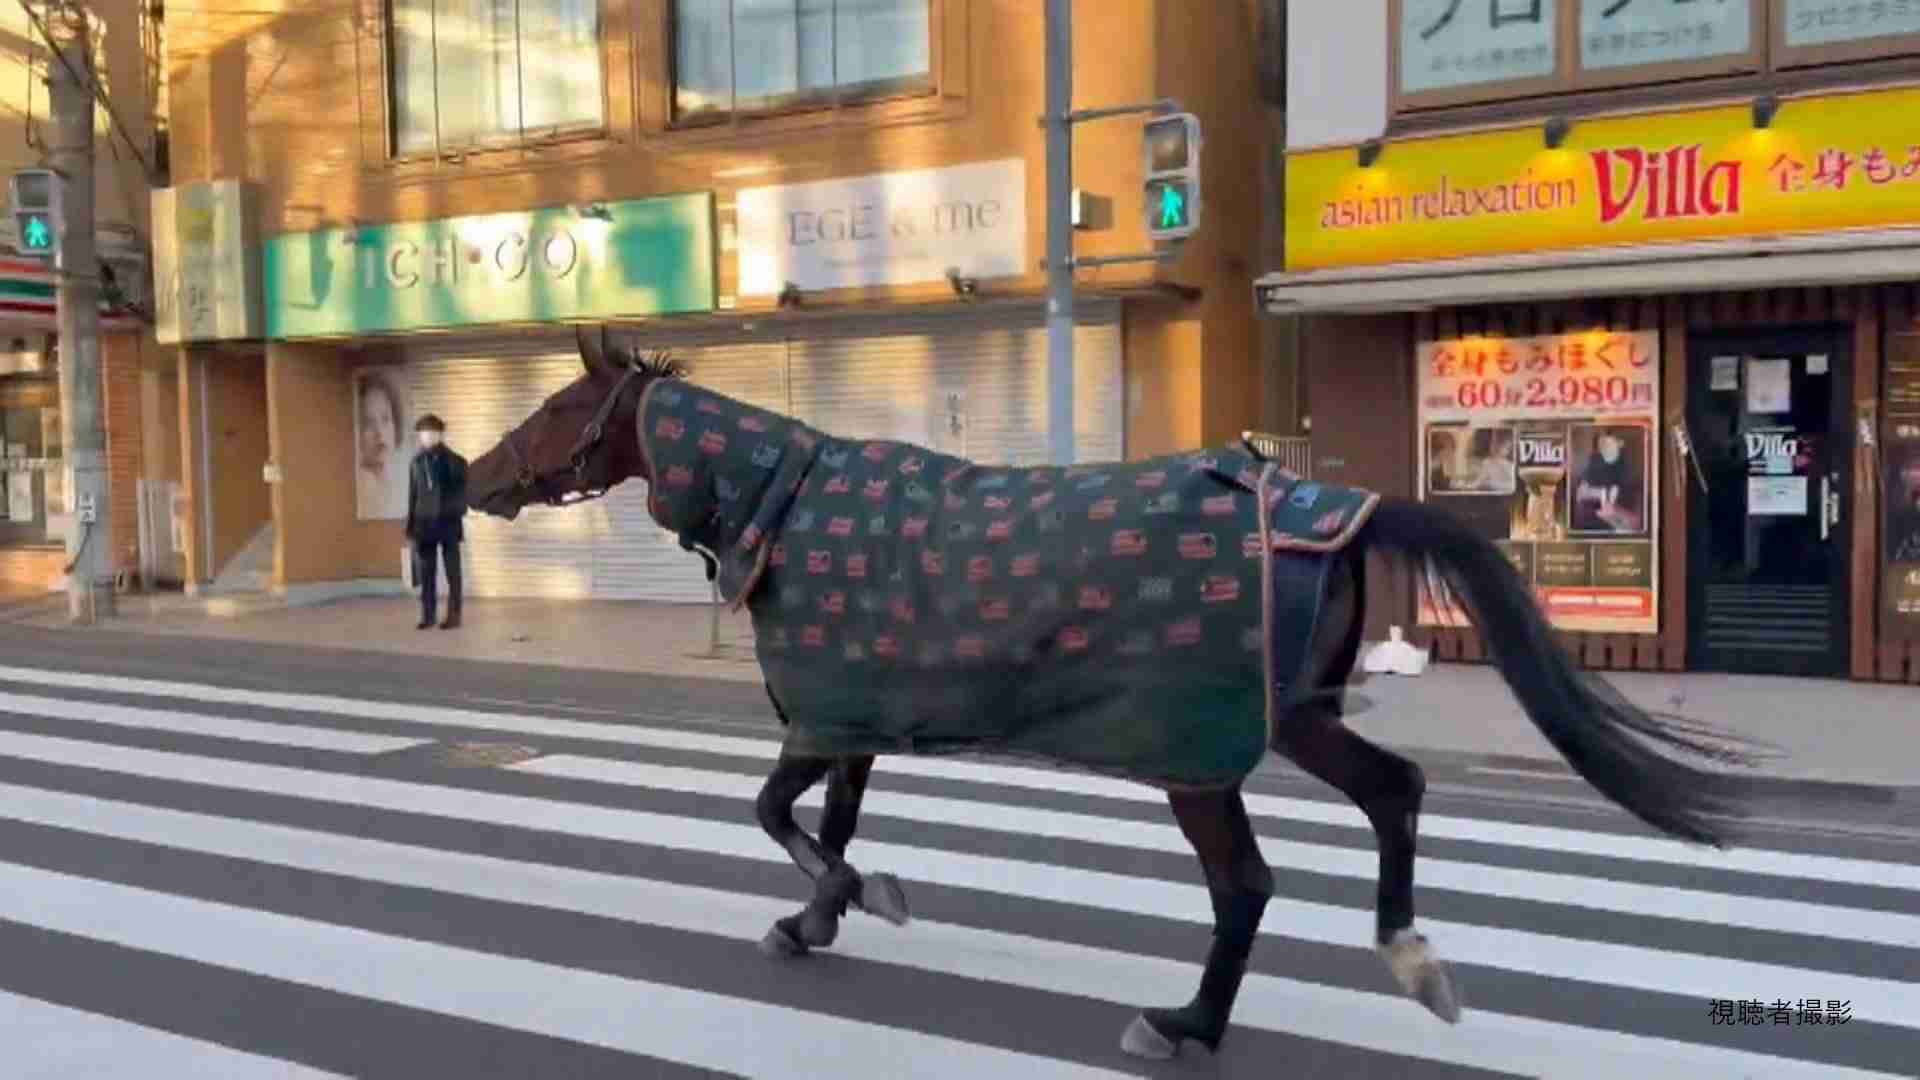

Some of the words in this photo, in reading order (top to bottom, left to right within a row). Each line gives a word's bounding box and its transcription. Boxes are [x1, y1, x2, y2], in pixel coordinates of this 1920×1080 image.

[1321, 183, 1404, 227] asian
[1412, 167, 1577, 220] relaxation
[1589, 142, 1742, 223] Villa
[787, 205, 876, 247] EGE
[933, 196, 1001, 234] me
[1519, 438, 1564, 464] Villa
[1743, 432, 1798, 458] Villa
